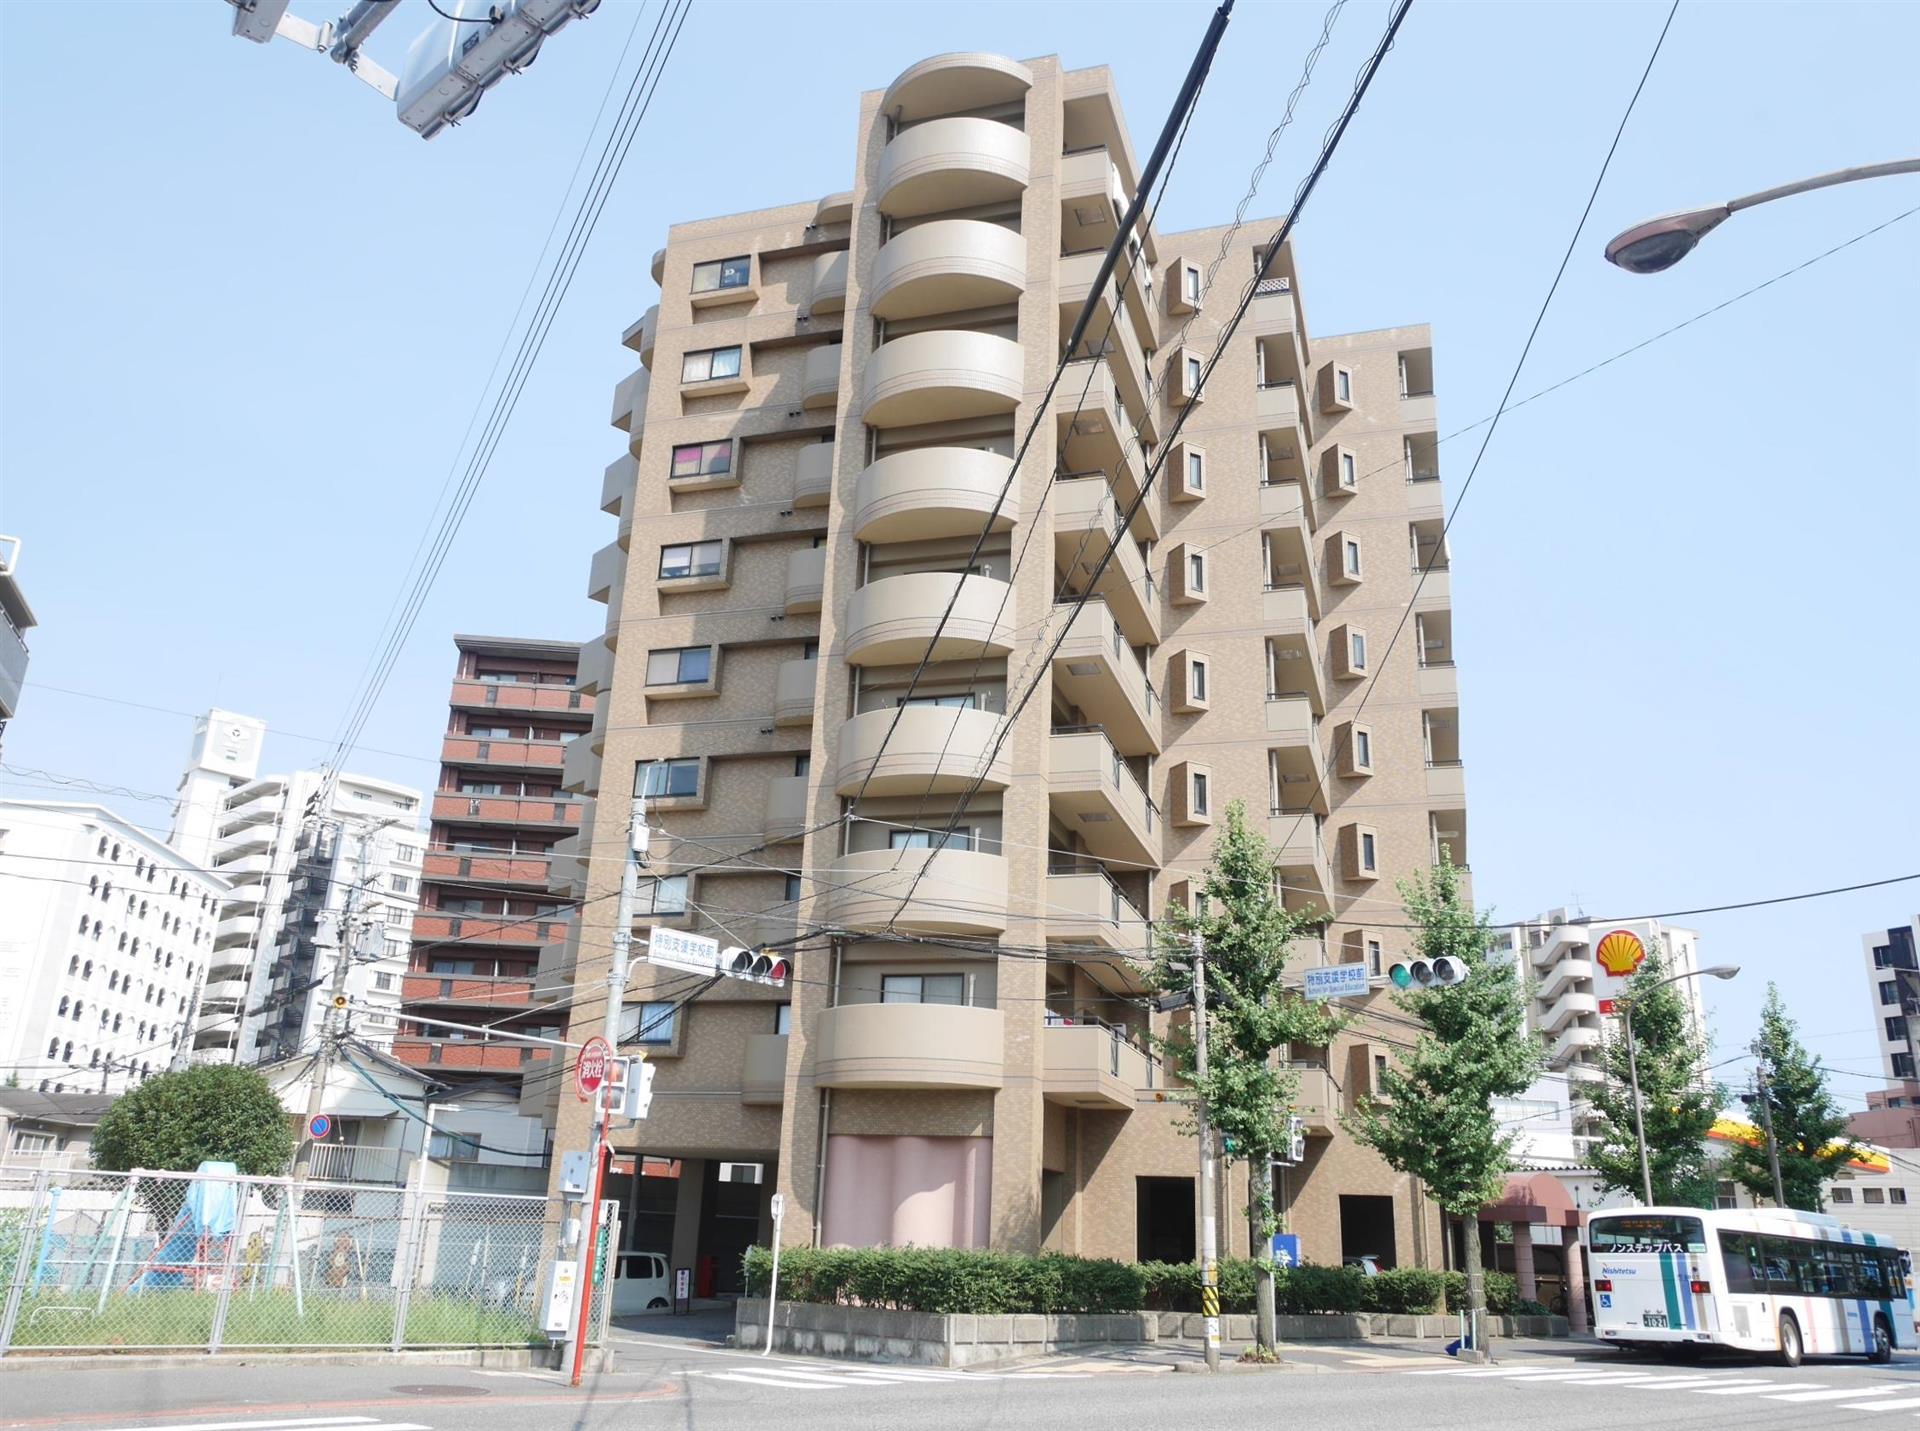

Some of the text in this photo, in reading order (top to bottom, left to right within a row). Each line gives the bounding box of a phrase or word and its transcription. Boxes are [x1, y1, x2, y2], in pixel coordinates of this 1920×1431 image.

[655, 932, 715, 960] 特別支援学校前
[1307, 968, 1364, 985] 特別支援学校前
[581, 1059, 603, 1079] 消火栓
[1610, 1241, 1684, 1253] ノンステップバス
[1602, 1266, 1637, 1276] Nishitetsu
